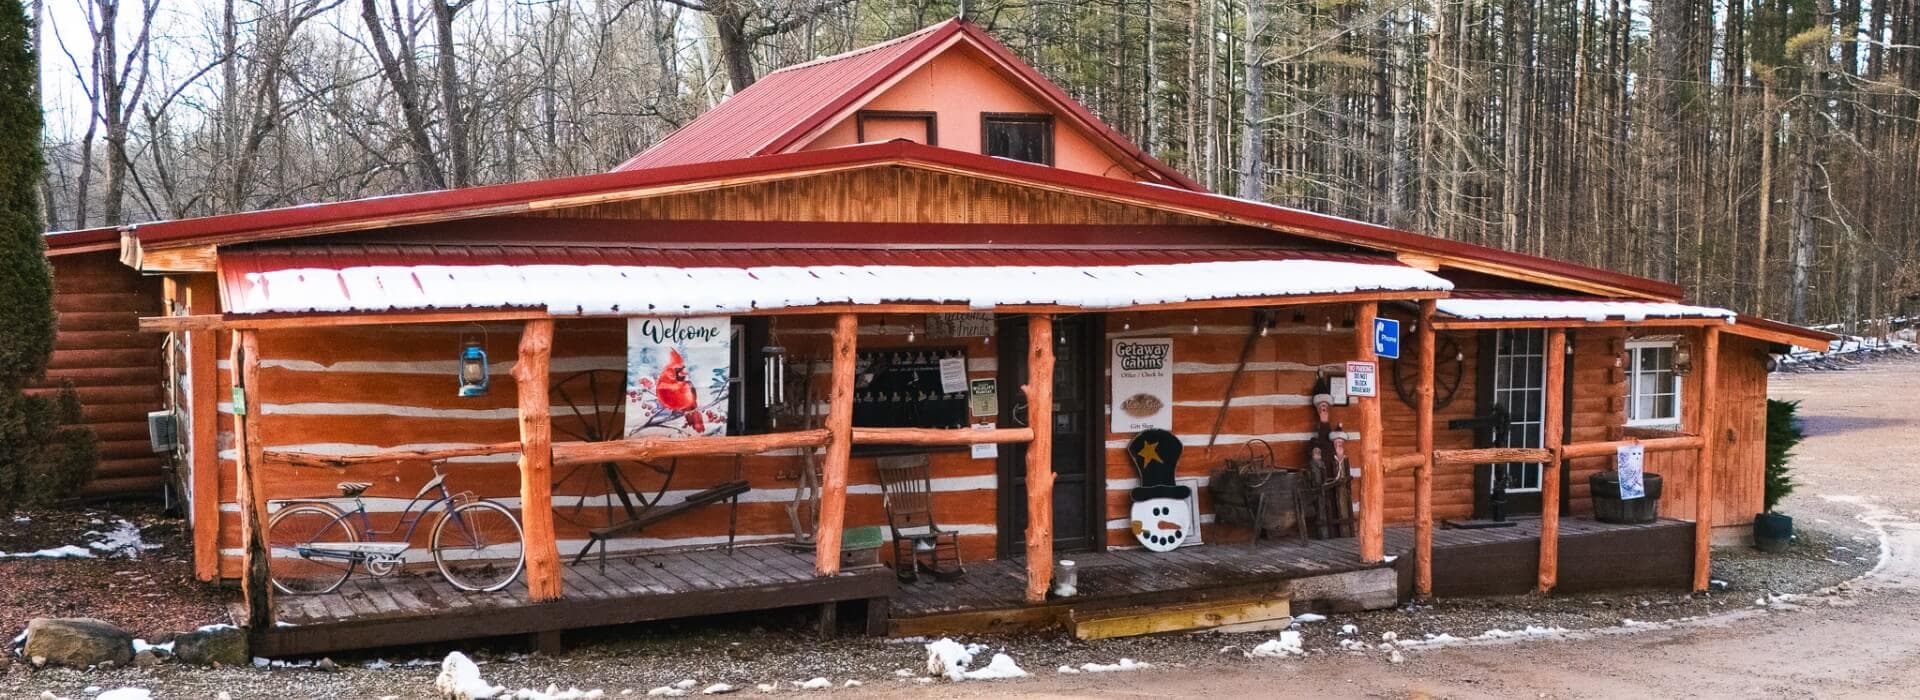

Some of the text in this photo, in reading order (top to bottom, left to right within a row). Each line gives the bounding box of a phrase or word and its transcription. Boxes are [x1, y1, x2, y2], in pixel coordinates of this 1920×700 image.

[642, 316, 721, 345] Welcome
[1381, 334, 1397, 343] Phone
[1116, 342, 1169, 358] Getaway
[1121, 356, 1163, 370] Cabins
